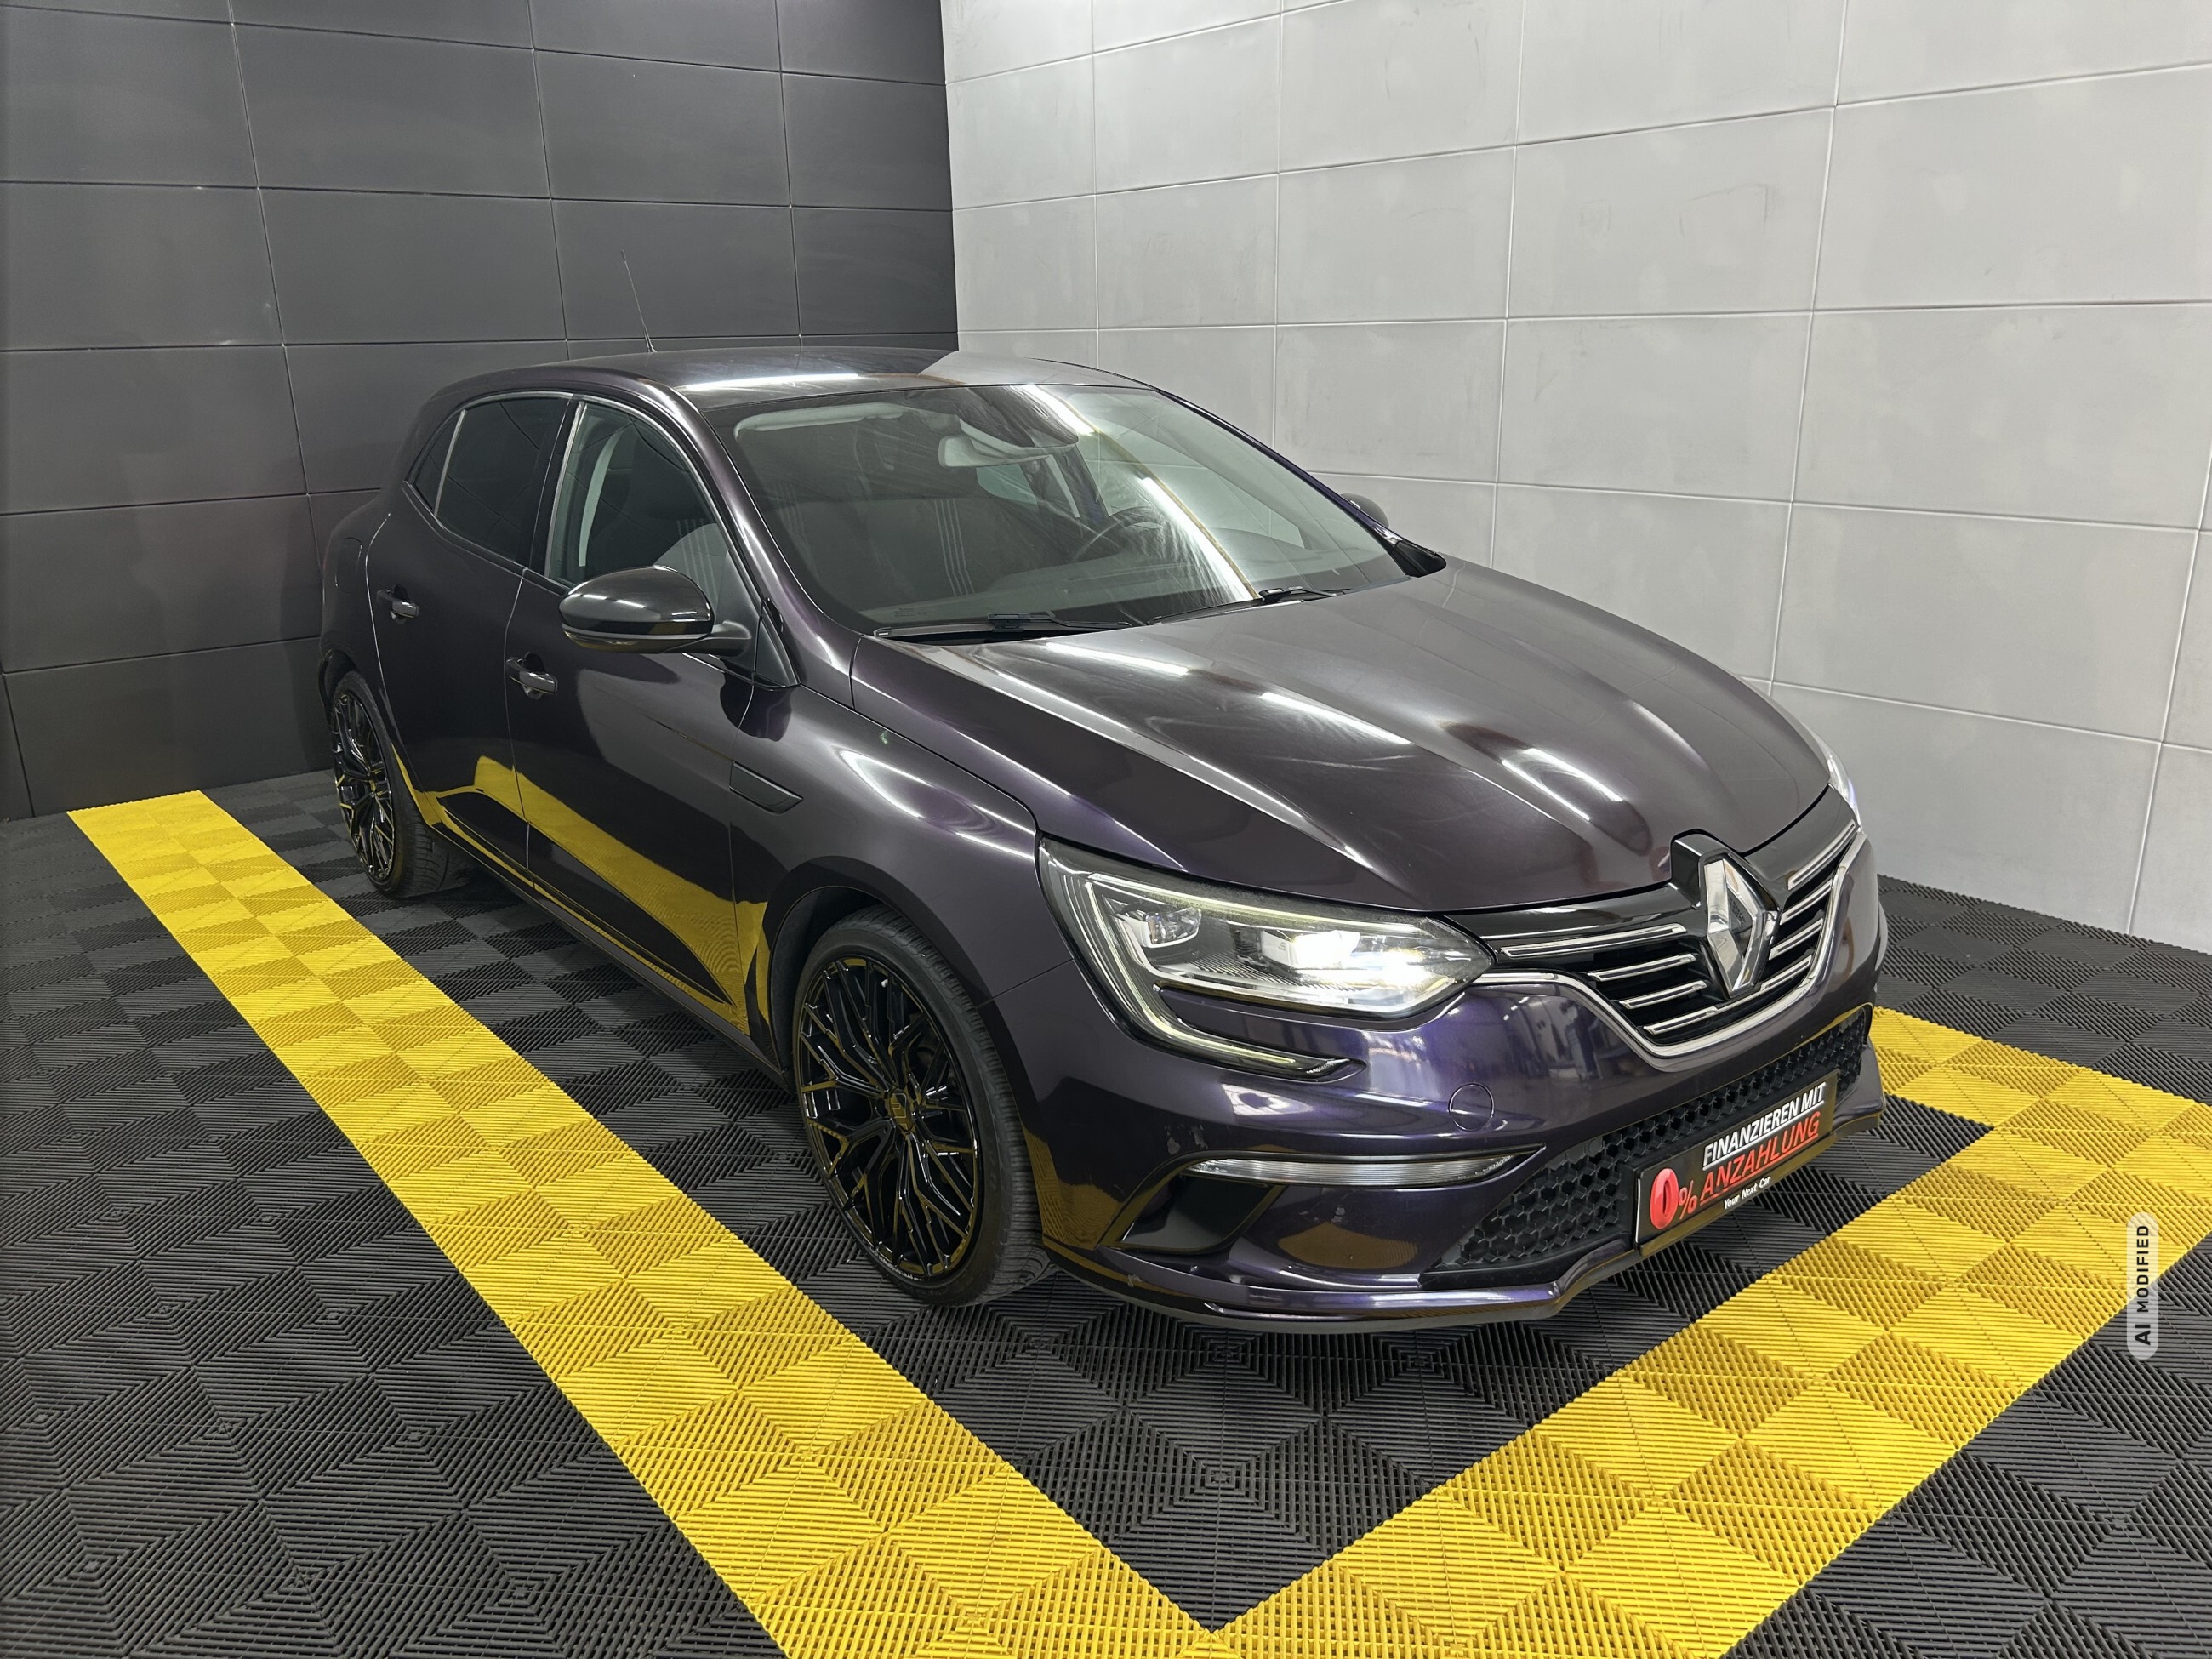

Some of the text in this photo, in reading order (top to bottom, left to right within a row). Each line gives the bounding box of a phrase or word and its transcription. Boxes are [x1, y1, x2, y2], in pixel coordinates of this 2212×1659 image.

[1702, 1082, 1826, 1166] FINANZIEREN MIT
[1650, 1111, 1821, 1230] 0% ANZAHLUNG
[1724, 1176, 1771, 1210] Your Next Car
